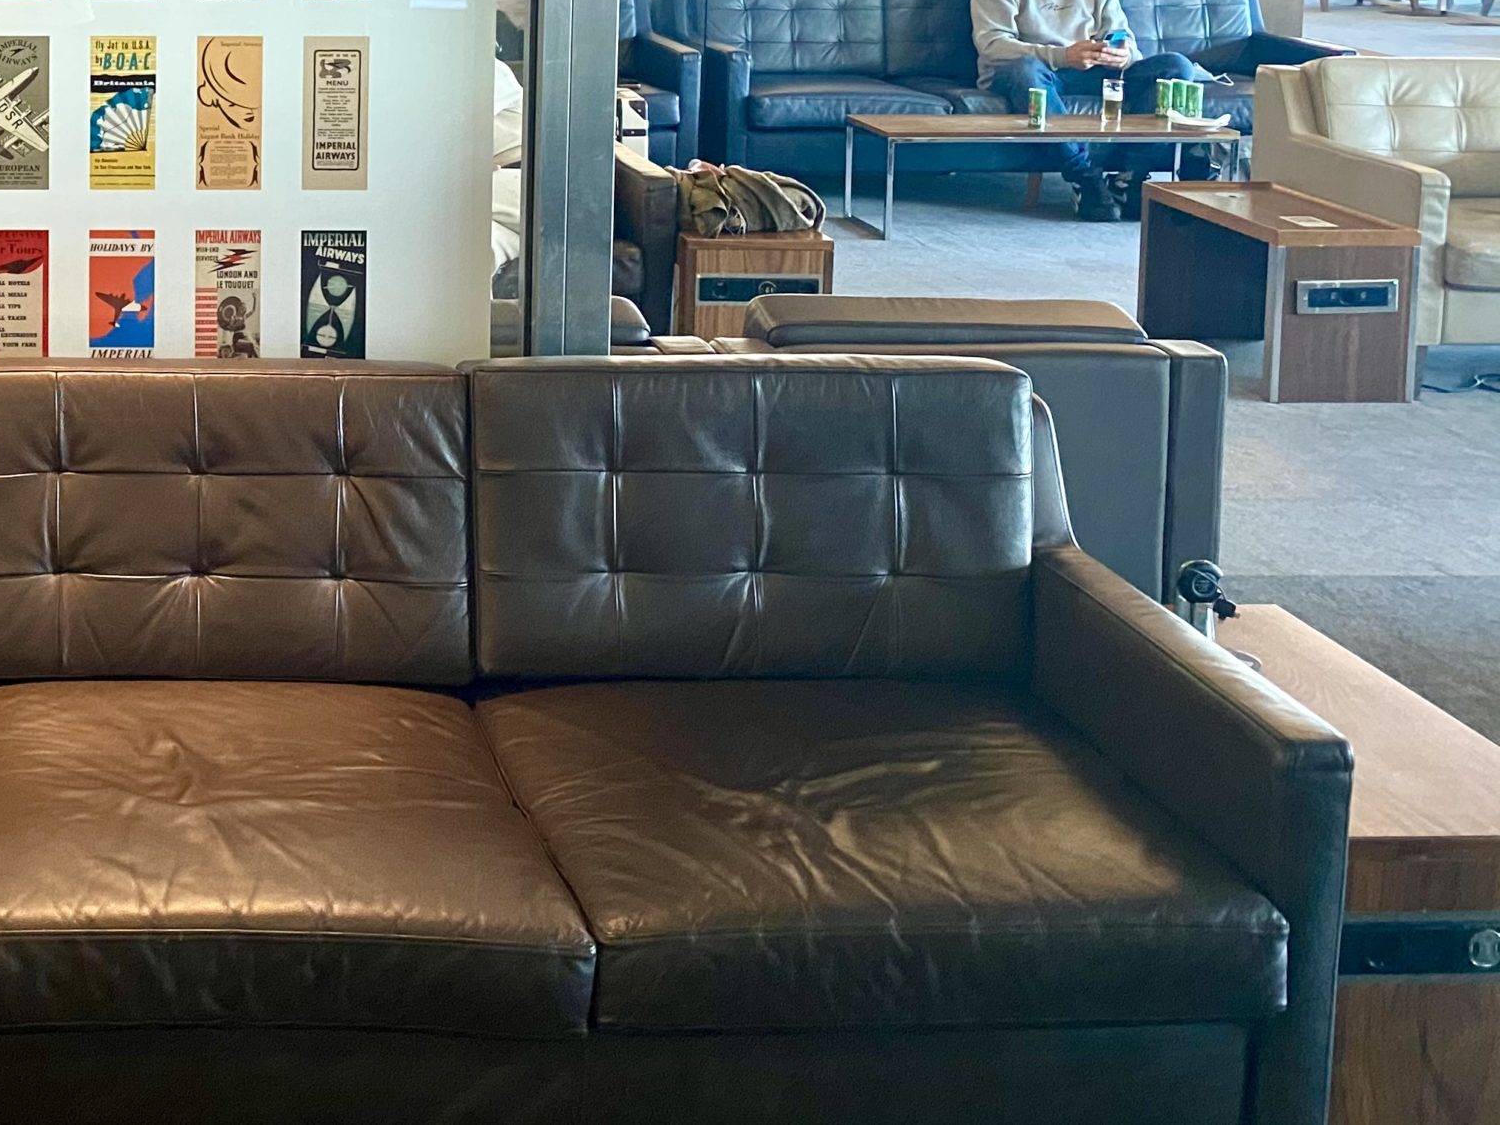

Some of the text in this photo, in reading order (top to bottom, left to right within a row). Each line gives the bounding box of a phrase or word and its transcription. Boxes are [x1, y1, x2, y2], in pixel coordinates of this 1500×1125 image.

[95, 40, 105, 51] fly
[107, 40, 119, 50] Jet
[121, 40, 129, 50] to
[95, 54, 103, 66] by
[315, 142, 357, 150] IMPERIAL
[315, 151, 356, 160] AIRWAYS
[195, 230, 261, 243] IMPERIAL AIRWAYS
[303, 233, 365, 247] IMPERIAL
[89, 243, 154, 252] HOLIDAYS BY
[315, 247, 366, 264] AIRWAYS
[225, 281, 254, 289] TOUQUET
[90, 349, 153, 358] IMPERIAL
